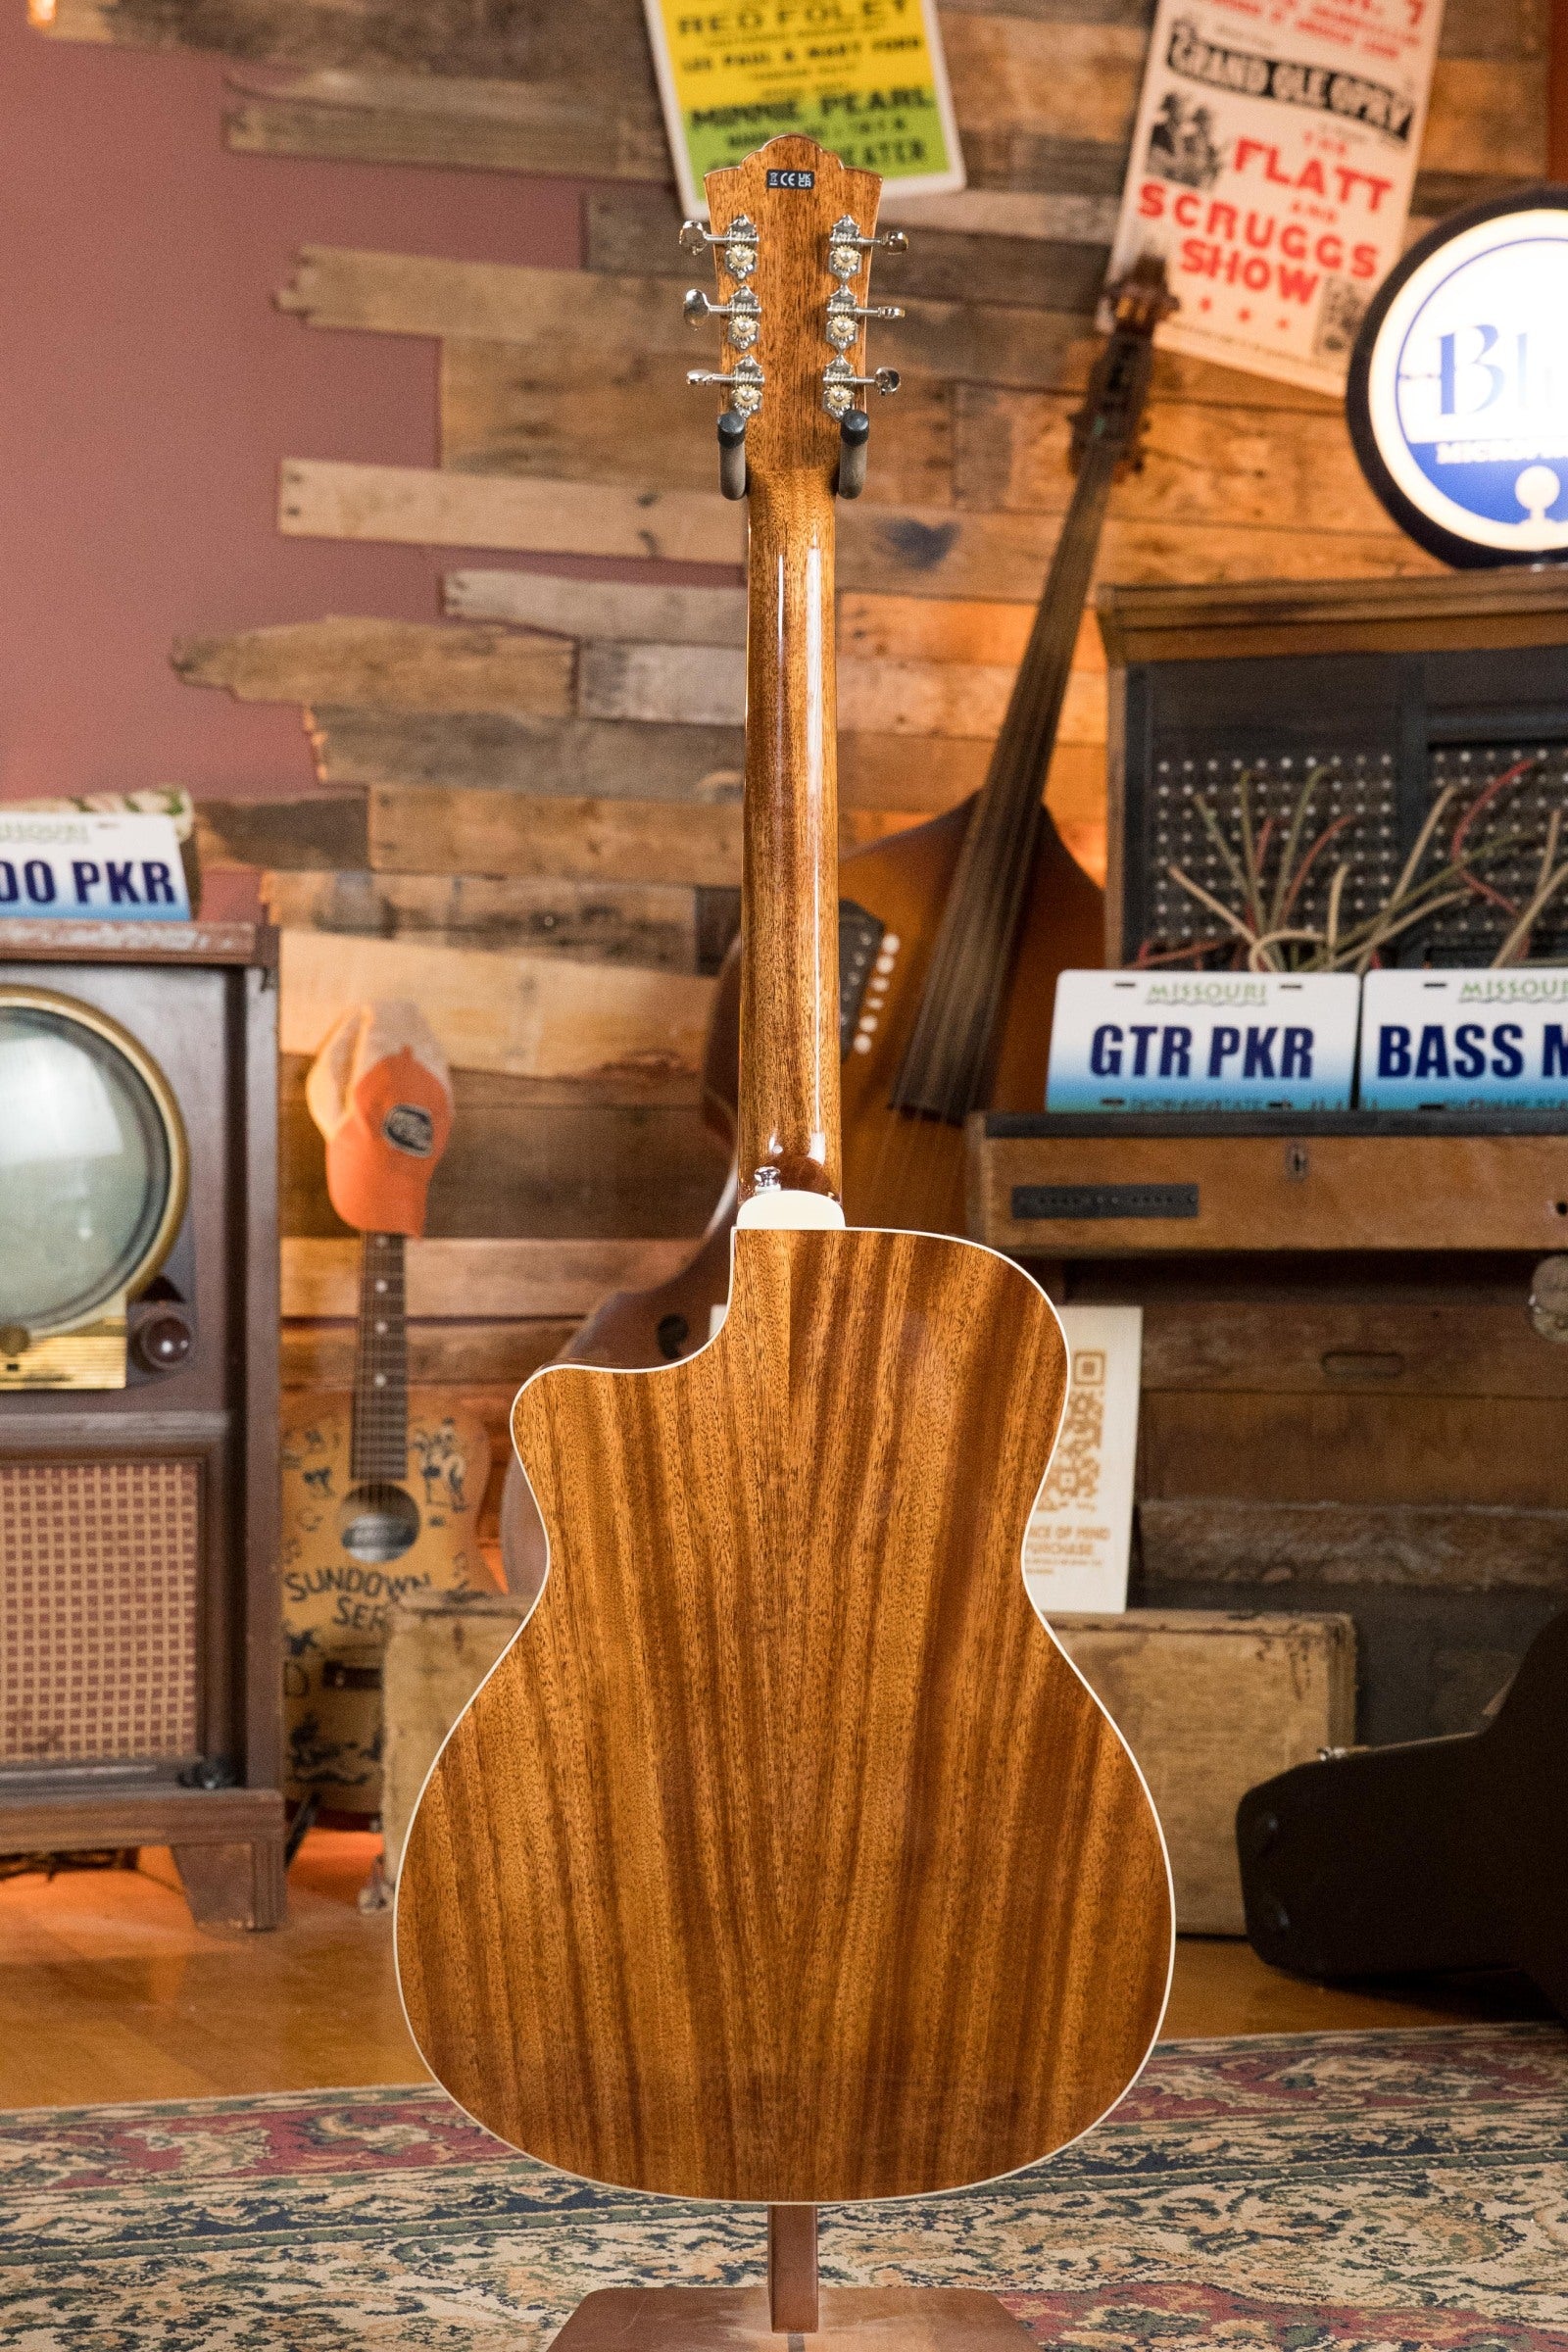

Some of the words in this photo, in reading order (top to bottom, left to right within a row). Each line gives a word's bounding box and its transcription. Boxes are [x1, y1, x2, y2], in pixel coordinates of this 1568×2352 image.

[690, 99, 801, 132] MINNIE
[820, 84, 935, 117] PEARL
[1168, 22, 1268, 97] GRAND
[1273, 61, 1326, 106] OLE
[1329, 74, 1413, 140] OPRY
[780, 172, 796, 186] CE
[1233, 136, 1394, 213] FLATT
[1138, 182, 1378, 280] SCRUGGS
[1180, 238, 1319, 307] SHOW
[72, 860, 175, 904] PKR
[1149, 981, 1270, 1002] MISSOURI
[1089, 1024, 1194, 1079] GTR
[1206, 1025, 1315, 1079] PKR
[1378, 1023, 1525, 1079] BASS
[284, 1567, 431, 1602] SUNDOWN
